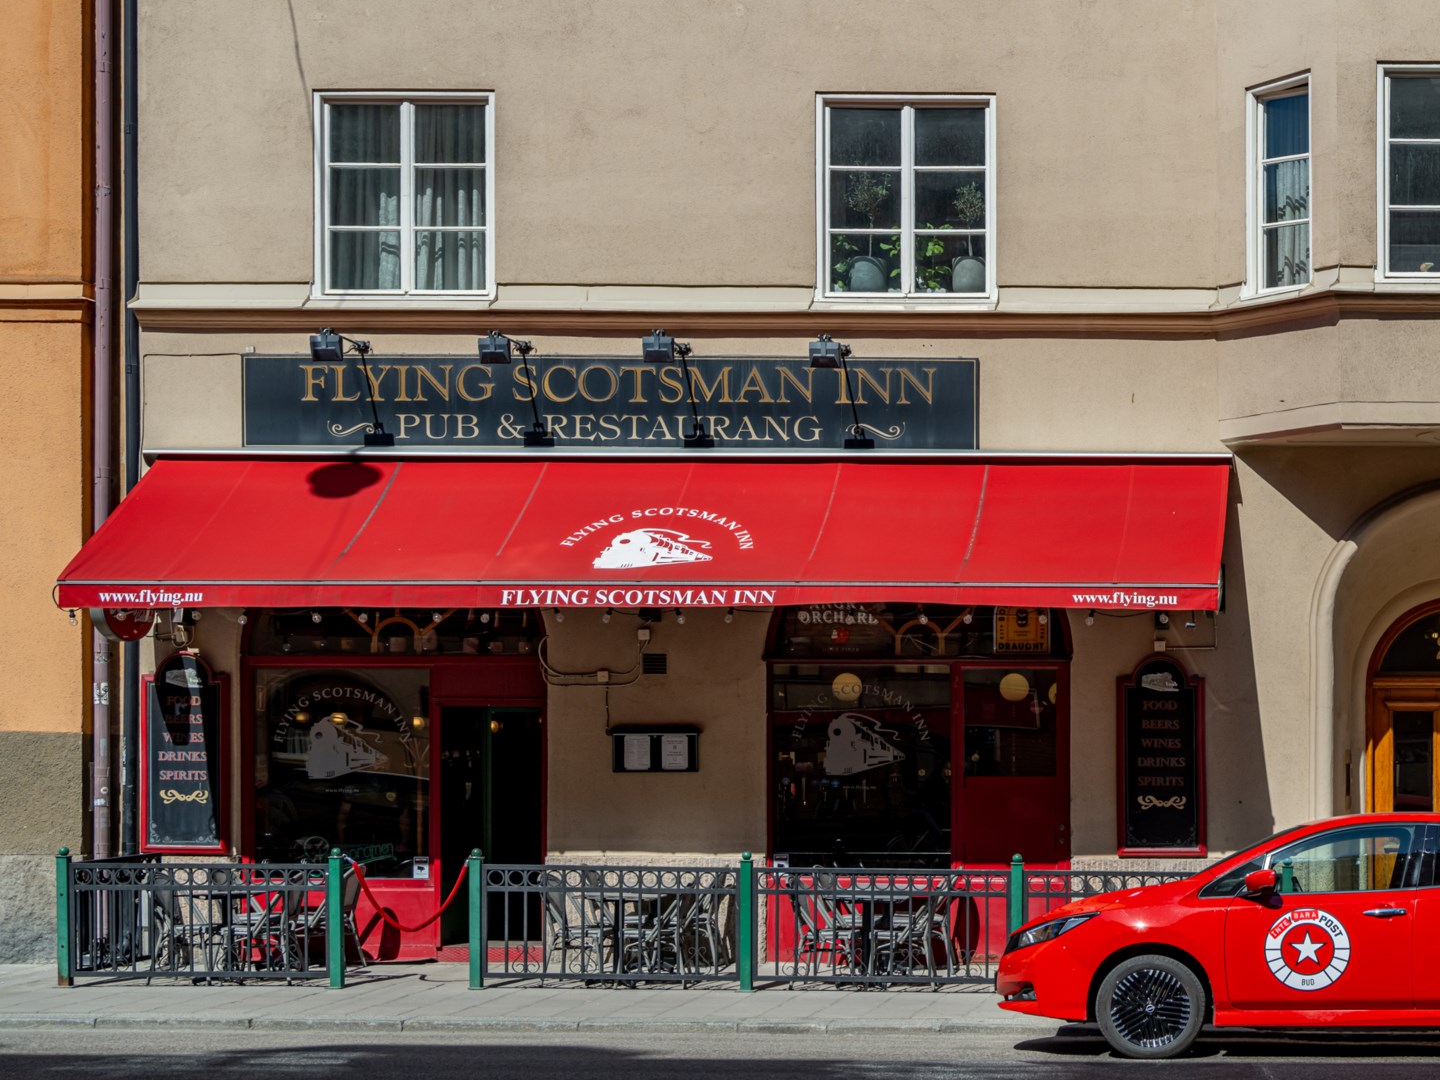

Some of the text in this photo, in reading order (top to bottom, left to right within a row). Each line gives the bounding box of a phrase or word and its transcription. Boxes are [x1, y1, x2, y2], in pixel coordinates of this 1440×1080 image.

[299, 364, 937, 405] FLYING SCOTSMAN INN
[395, 413, 824, 442] PUB & RESTAURANG
[560, 507, 754, 550] FLYING SCOTSMAN INN
[98, 589, 204, 606] www.flying.nu
[500, 589, 777, 605] FLYING SCOTSMAN INN
[1072, 591, 1178, 608] www.flying.nu
[998, 642, 1044, 651] DRAUGHT
[166, 695, 202, 707] FOOD
[1142, 700, 1178, 711] FOOD
[164, 713, 203, 725] BEERS
[273, 687, 413, 743] FLYING SCOTSMAN INN
[791, 683, 931, 743] FLYING SCOTSMAN INN
[1141, 719, 1180, 730] BEERS
[162, 732, 205, 744] WINES
[1140, 738, 1182, 749] WINES
[158, 751, 208, 762] DRINKS
[1136, 757, 1186, 768] DRINKS
[159, 769, 208, 781] SPIRITS
[1137, 776, 1185, 787] SPIRITS
[1270, 911, 1344, 938] INTE BARA POST
[1301, 978, 1315, 986] BUD
